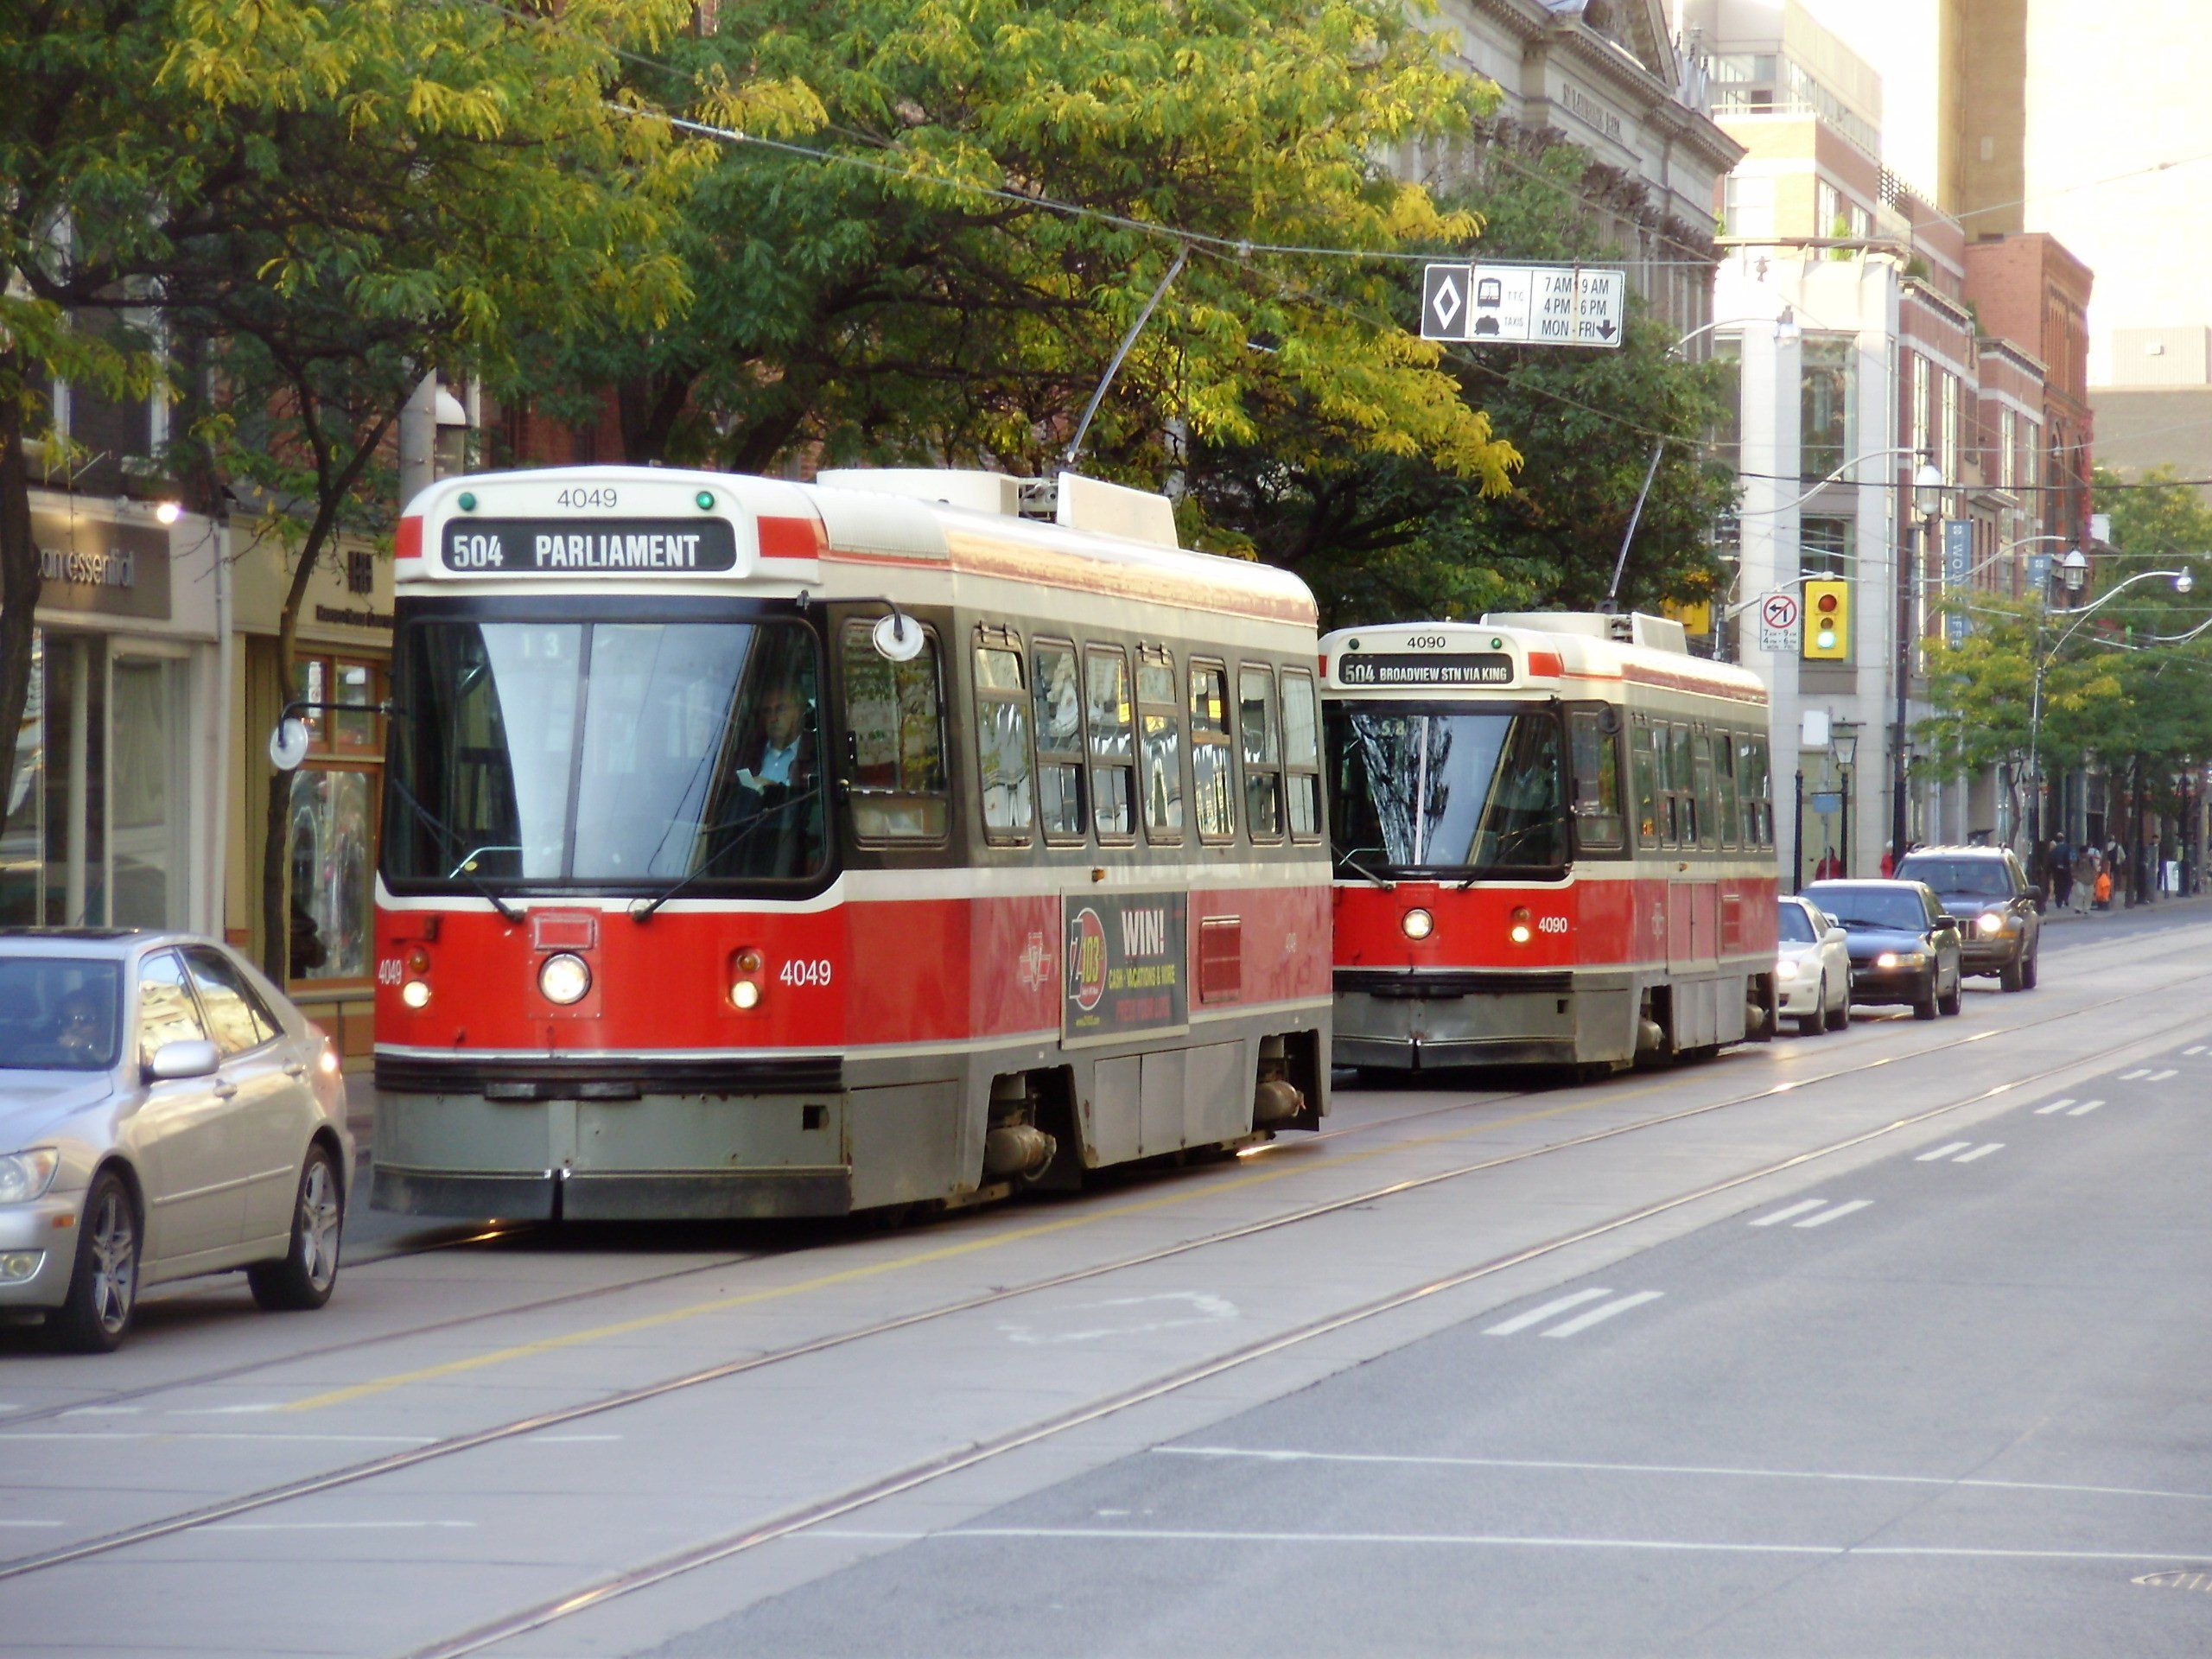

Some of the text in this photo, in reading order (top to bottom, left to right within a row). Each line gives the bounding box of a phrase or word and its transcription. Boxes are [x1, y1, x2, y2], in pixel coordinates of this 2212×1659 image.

[1545, 276, 1609, 294] 7 AM 9 AM
[1544, 298, 1607, 315] 4 PM 6 PM
[1541, 320, 1596, 337] MON FRI
[557, 488, 618, 508] 4049
[454, 535, 700, 567] 504 PARLIAMENT
[1407, 637, 1446, 648] 4090
[1345, 664, 1507, 683] 504 BROADVIEW STN VIA KING
[1121, 909, 1164, 956] WIN!
[1538, 917, 1567, 932] 4090
[378, 959, 402, 984] 4049
[779, 959, 831, 986] 4049
